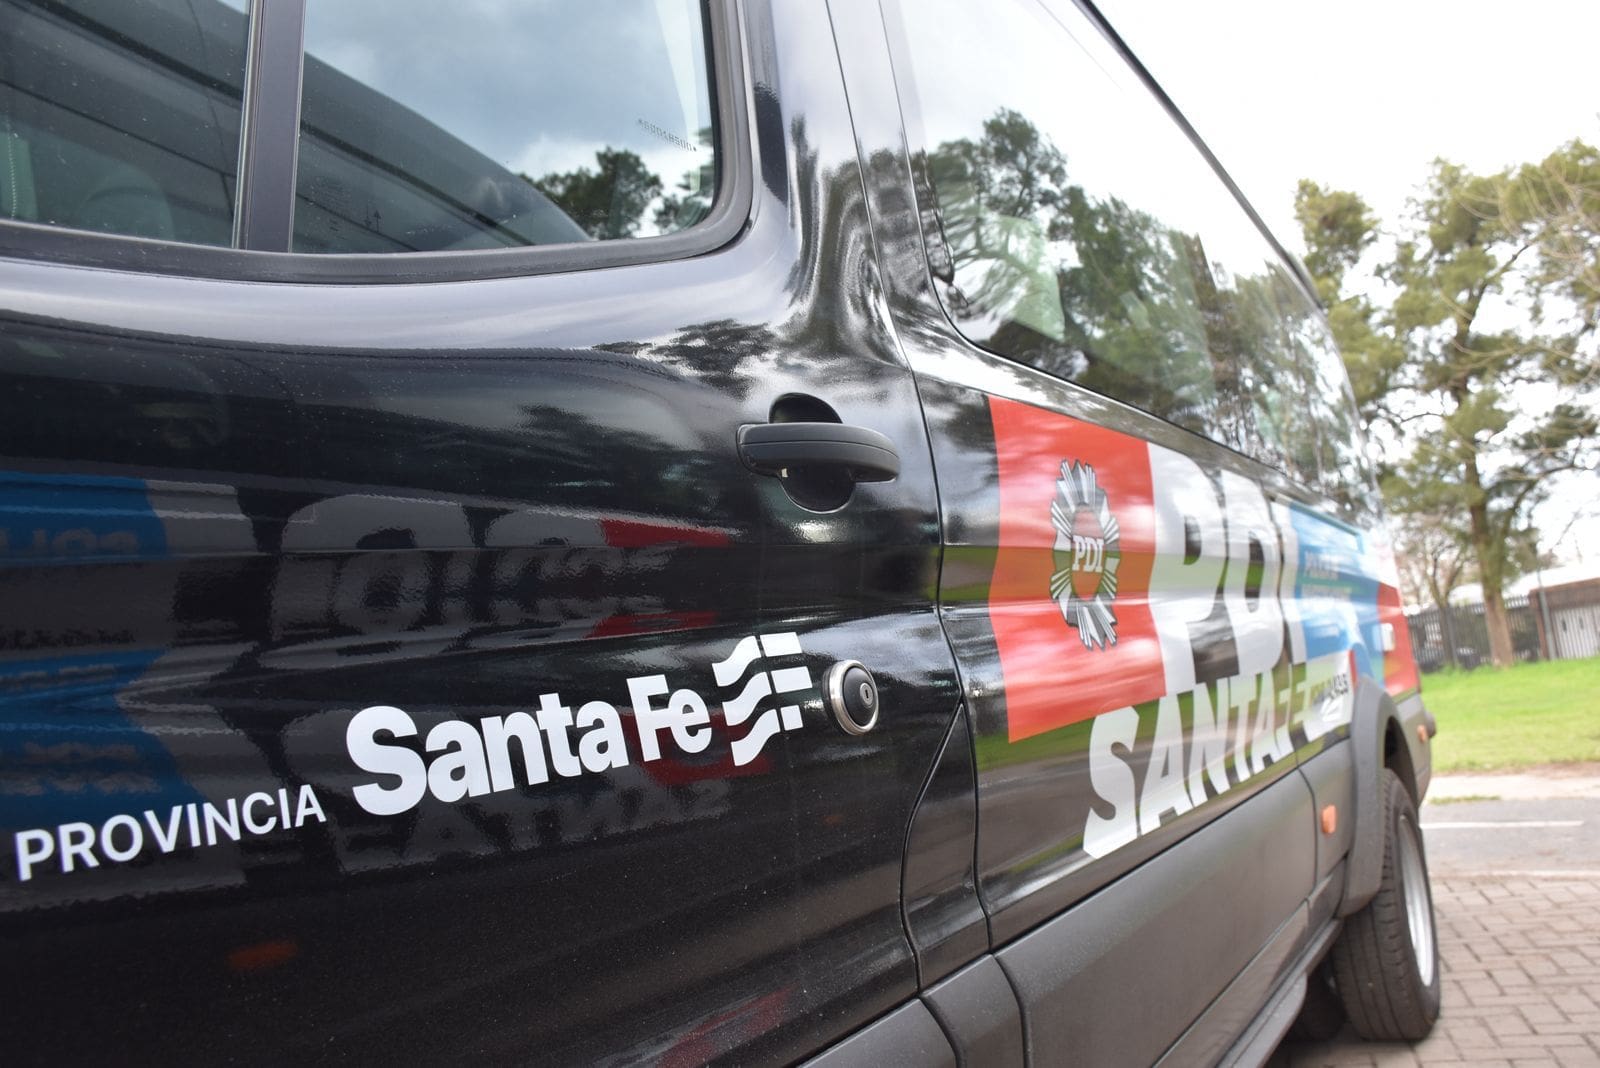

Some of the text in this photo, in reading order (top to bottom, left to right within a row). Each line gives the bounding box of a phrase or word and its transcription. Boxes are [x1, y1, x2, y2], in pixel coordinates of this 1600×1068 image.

[1071, 534, 1105, 573] PDI
[1147, 440, 1307, 699] PDI
[15, 783, 327, 882] PROVINCIA
